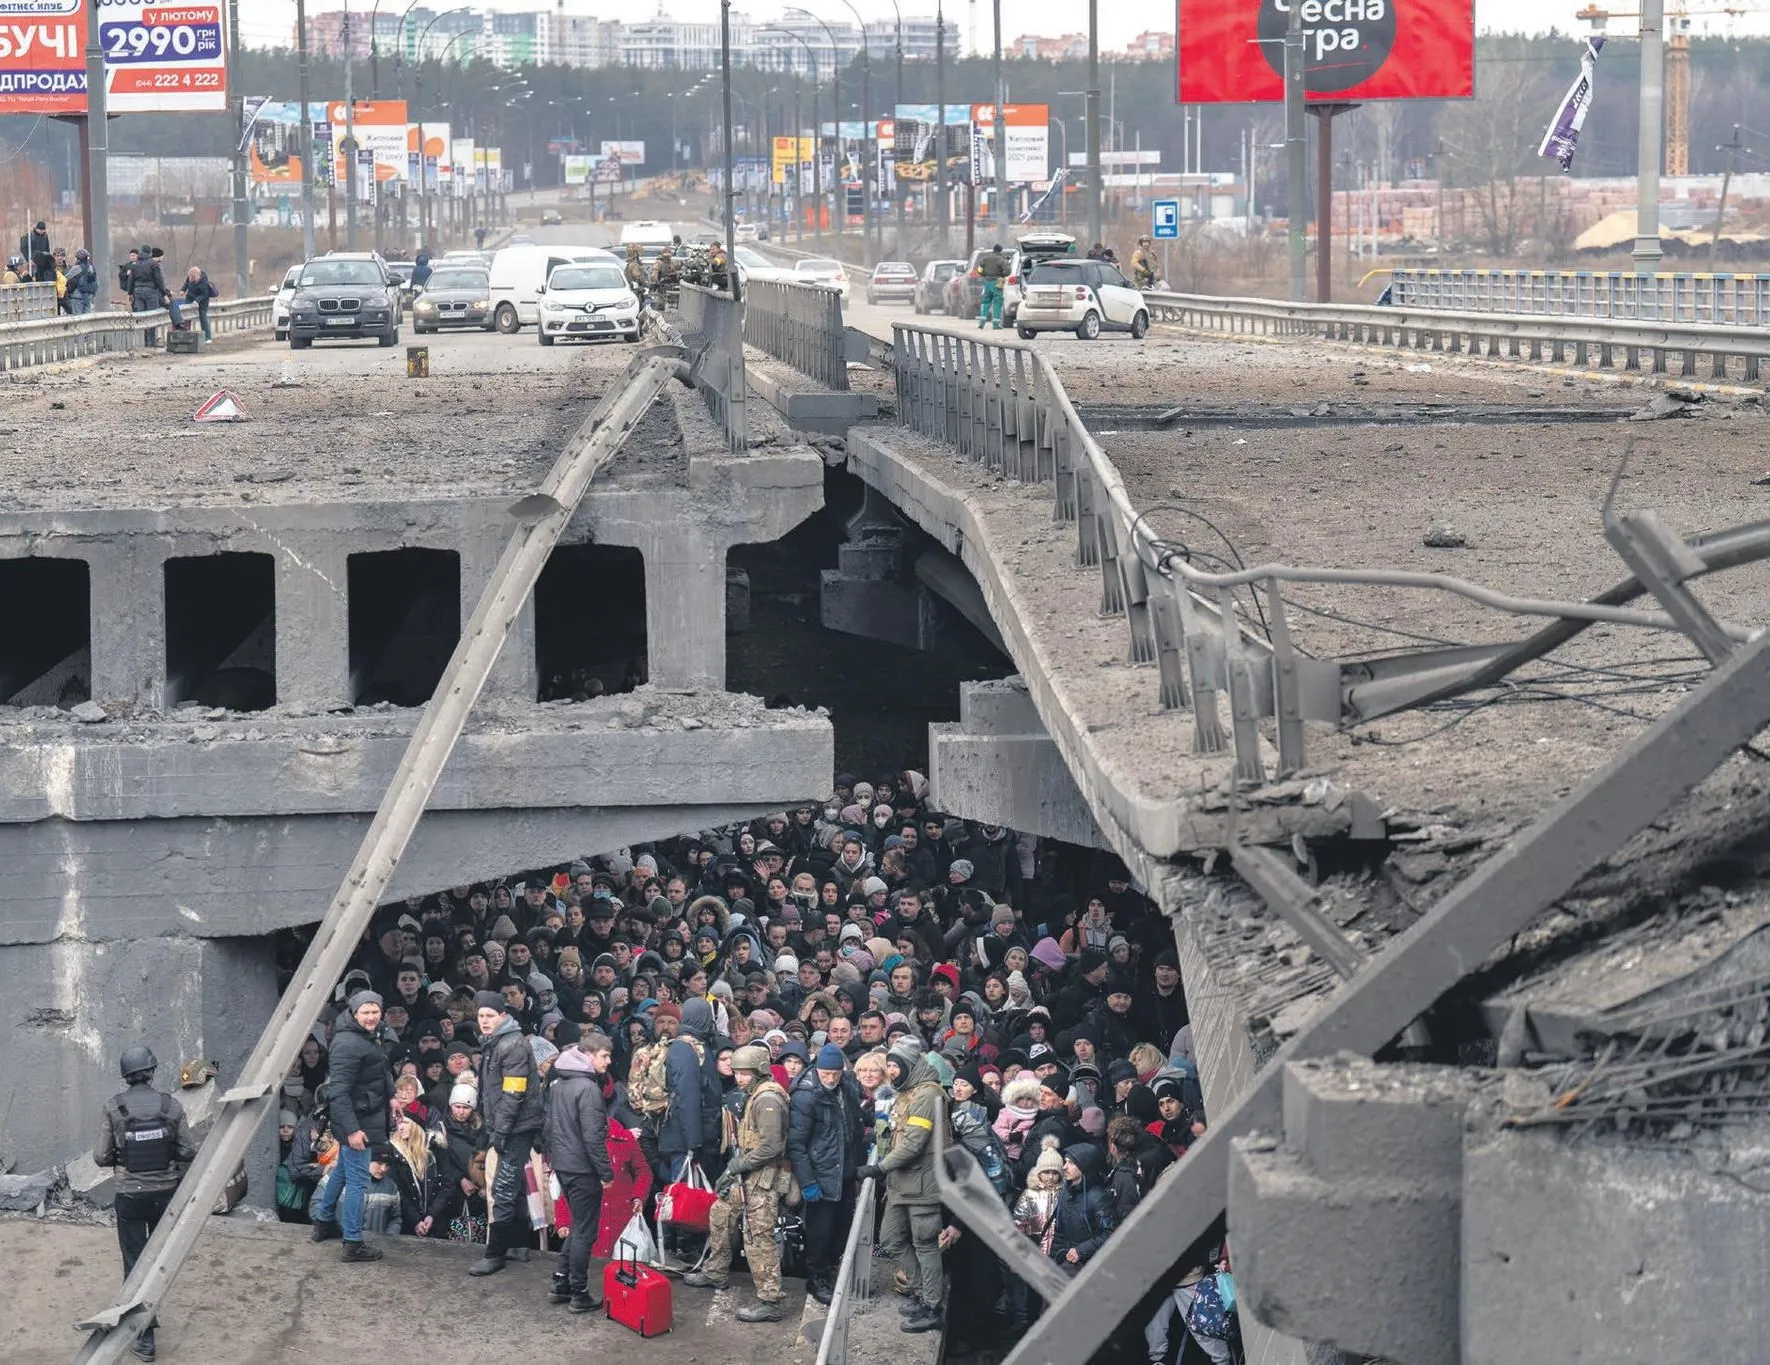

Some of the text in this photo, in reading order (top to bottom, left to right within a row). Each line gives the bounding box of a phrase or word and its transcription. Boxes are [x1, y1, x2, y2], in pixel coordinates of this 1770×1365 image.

[160, 10, 214, 23] лютому
[107, 25, 216, 58] 2990 грн
[197, 40, 216, 52] рік
[154, 74, 179, 87] 222
[182, 74, 191, 86] 4
[194, 73, 219, 86] 222
[137, 1130, 162, 1140] PRESS
